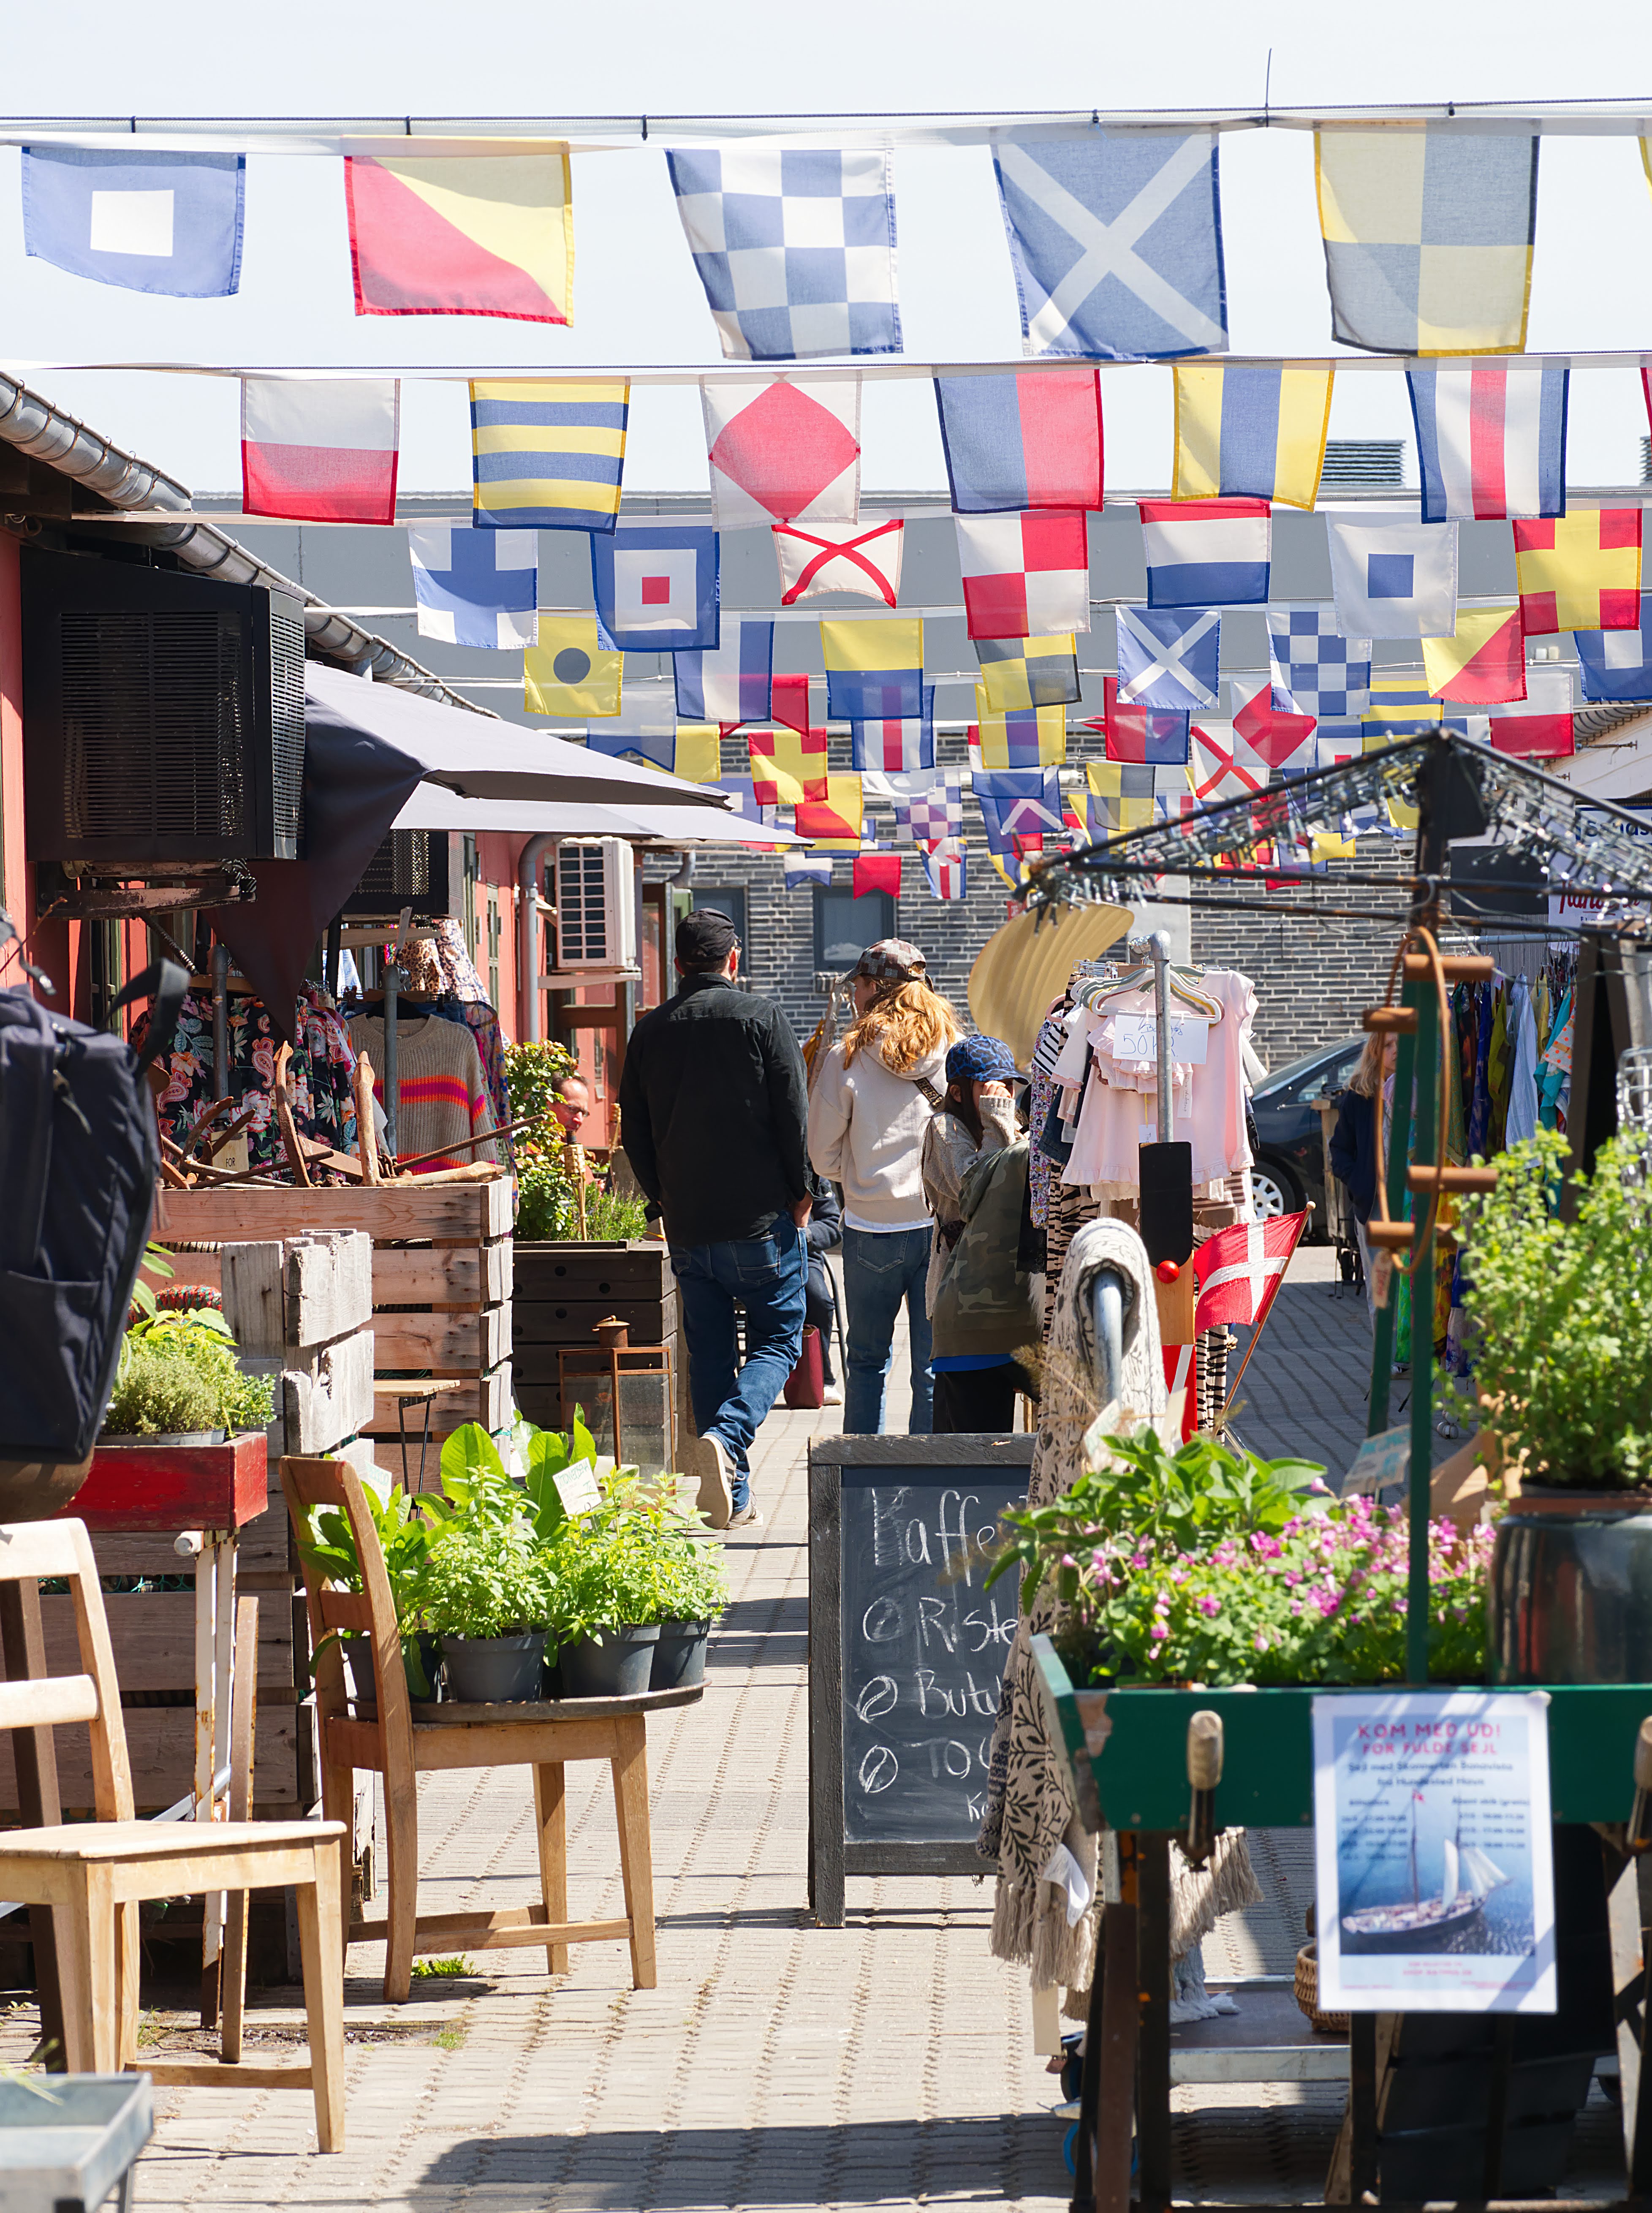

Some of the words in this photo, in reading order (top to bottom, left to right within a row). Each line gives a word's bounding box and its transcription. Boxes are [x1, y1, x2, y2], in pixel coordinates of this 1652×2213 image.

[226, 1157, 235, 1167] FOR
[1357, 1723, 1407, 1739] KOM
[1415, 1722, 1458, 1738] MED
[1467, 1723, 1501, 1738] UD!
[1362, 1742, 1395, 1755] FOR
